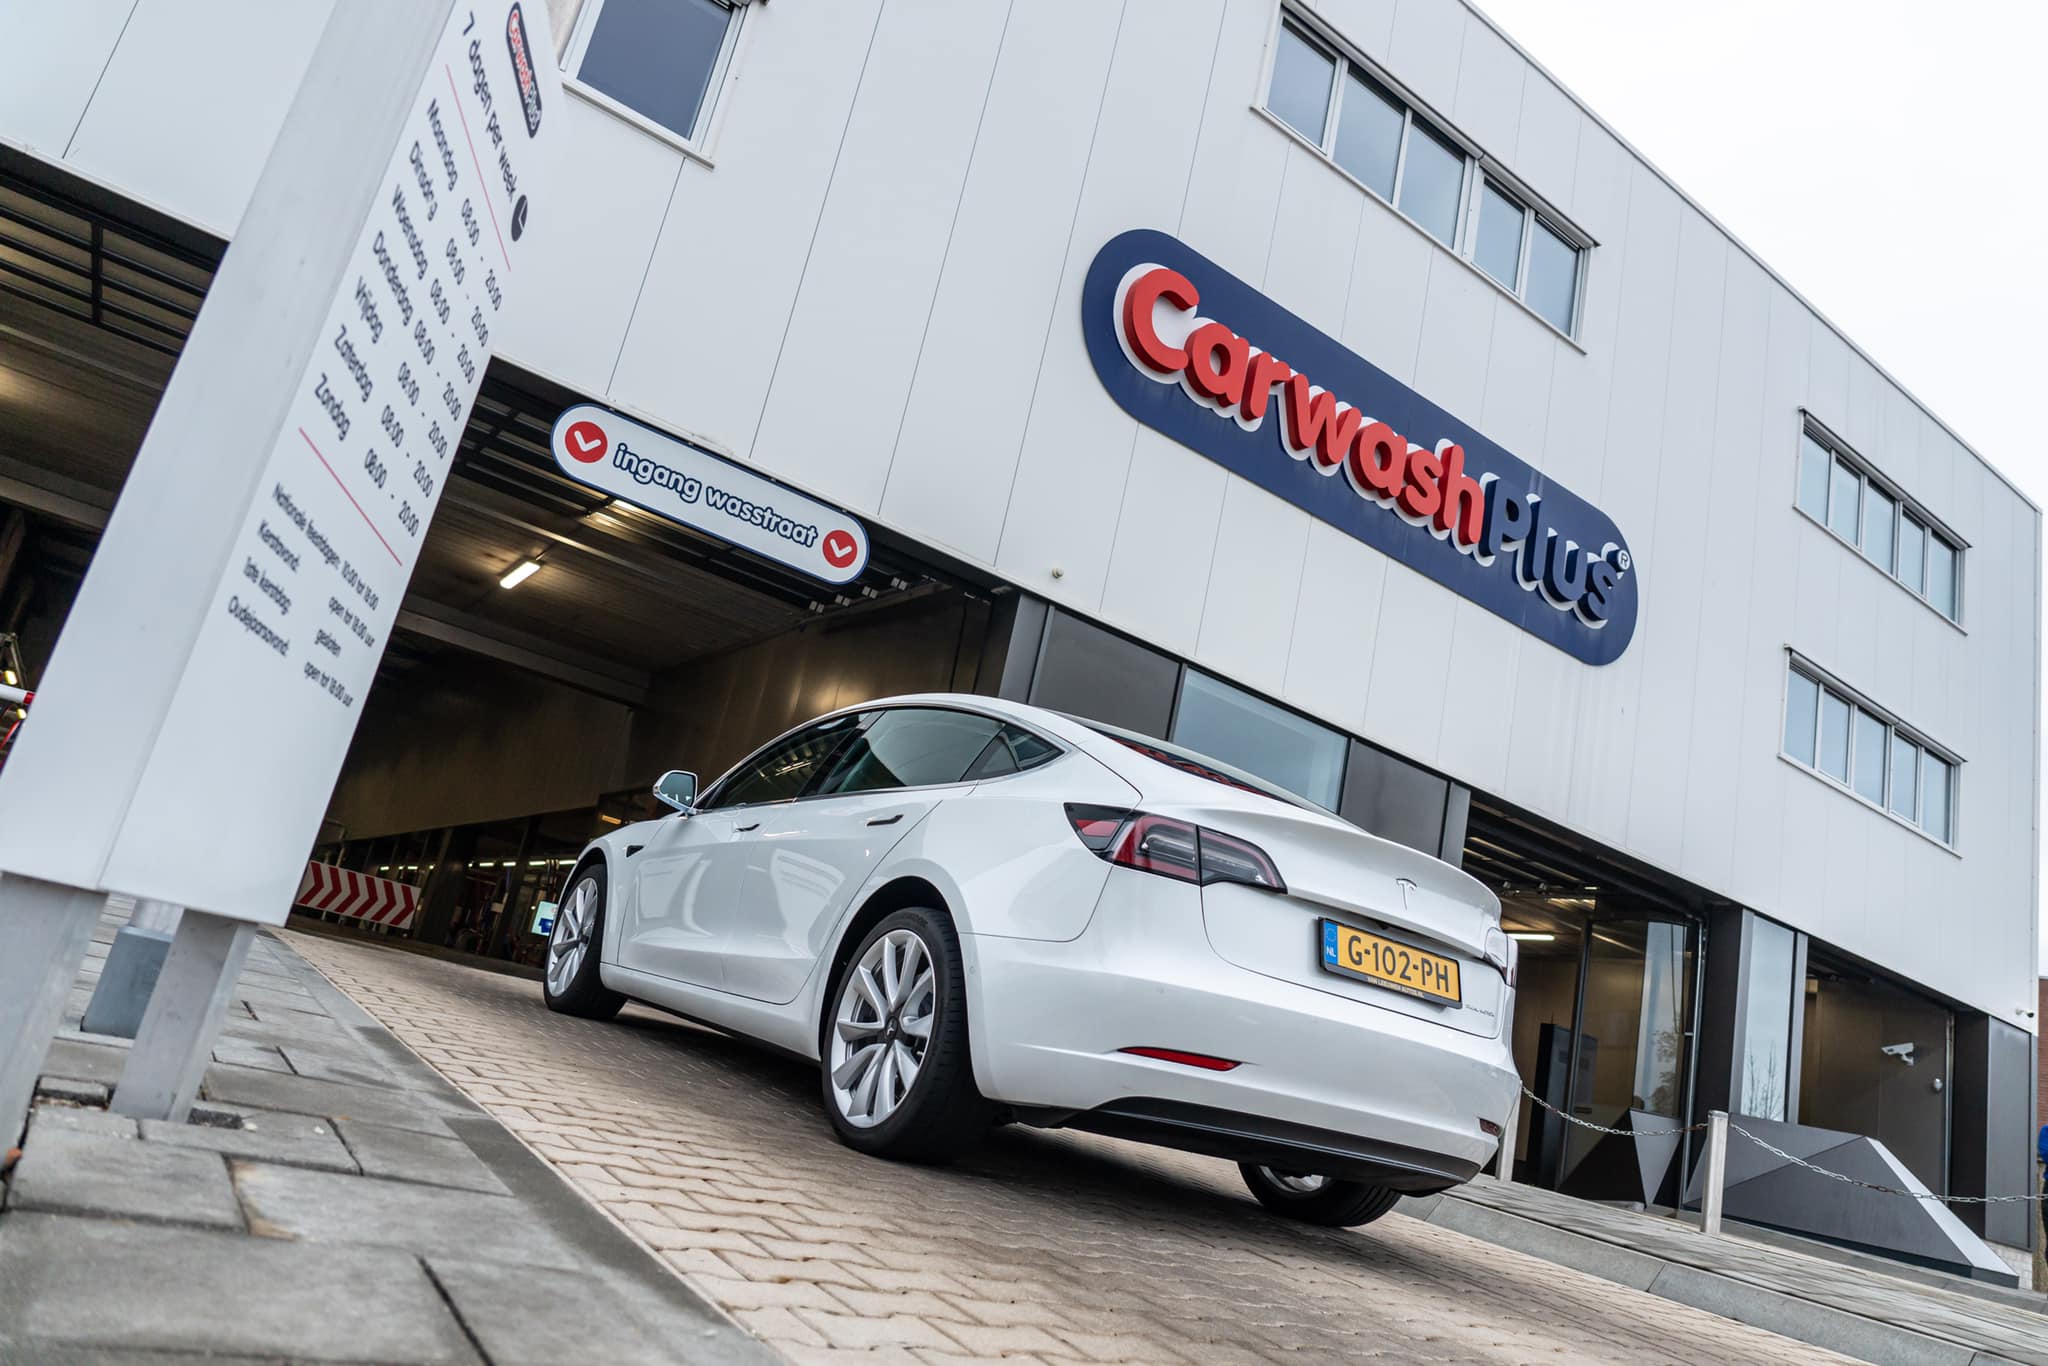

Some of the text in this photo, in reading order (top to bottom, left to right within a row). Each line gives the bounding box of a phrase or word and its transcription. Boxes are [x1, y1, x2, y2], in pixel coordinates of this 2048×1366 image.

[462, 11, 517, 203] 7 dagen per week
[392, 184, 428, 280] Woensdag
[430, 278, 450, 325] 08:00
[457, 344, 475, 384] 20:00
[427, 98, 458, 192] Maandag
[461, 198, 479, 247] 08:00
[485, 268, 502, 311] 20:00
[355, 276, 383, 344] Vrijdag
[398, 361, 420, 407] 08:00
[428, 420, 447, 459] 20:00
[373, 230, 413, 327] Donderdag
[414, 320, 435, 365] 08:00
[443, 381, 461, 422] 20:00
[446, 238, 465, 286] 08:00
[471, 305, 488, 348] 20:00
[314, 372, 350, 442] Zondag
[364, 448, 387, 489] 08:00
[334, 324, 373, 403] Zaterdag
[381, 404, 404, 448] 08:00
[413, 460, 433, 498] 20:00
[613, 443, 818, 548] ingang wasstraat
[1326, 946, 1337, 958] NL
[1348, 935, 1450, 993] G-102-PH
